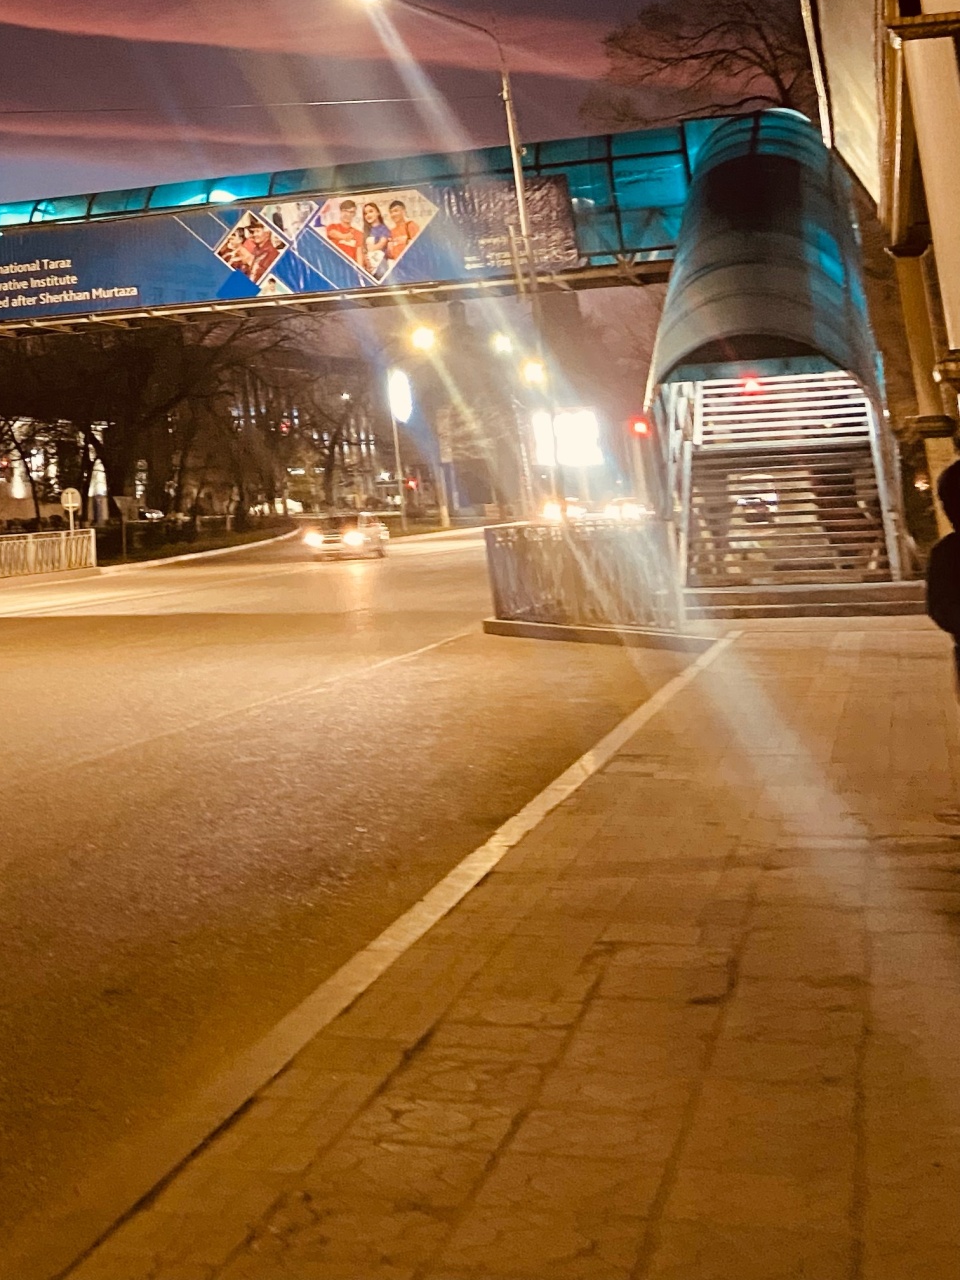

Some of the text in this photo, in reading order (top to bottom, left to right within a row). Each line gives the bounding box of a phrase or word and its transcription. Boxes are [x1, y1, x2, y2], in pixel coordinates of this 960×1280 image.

[41, 258, 72, 270] Taraz
[29, 274, 78, 288] Institute
[10, 294, 38, 307] after
[39, 290, 90, 305] Sherkhan
[91, 285, 138, 300] Murtaza
